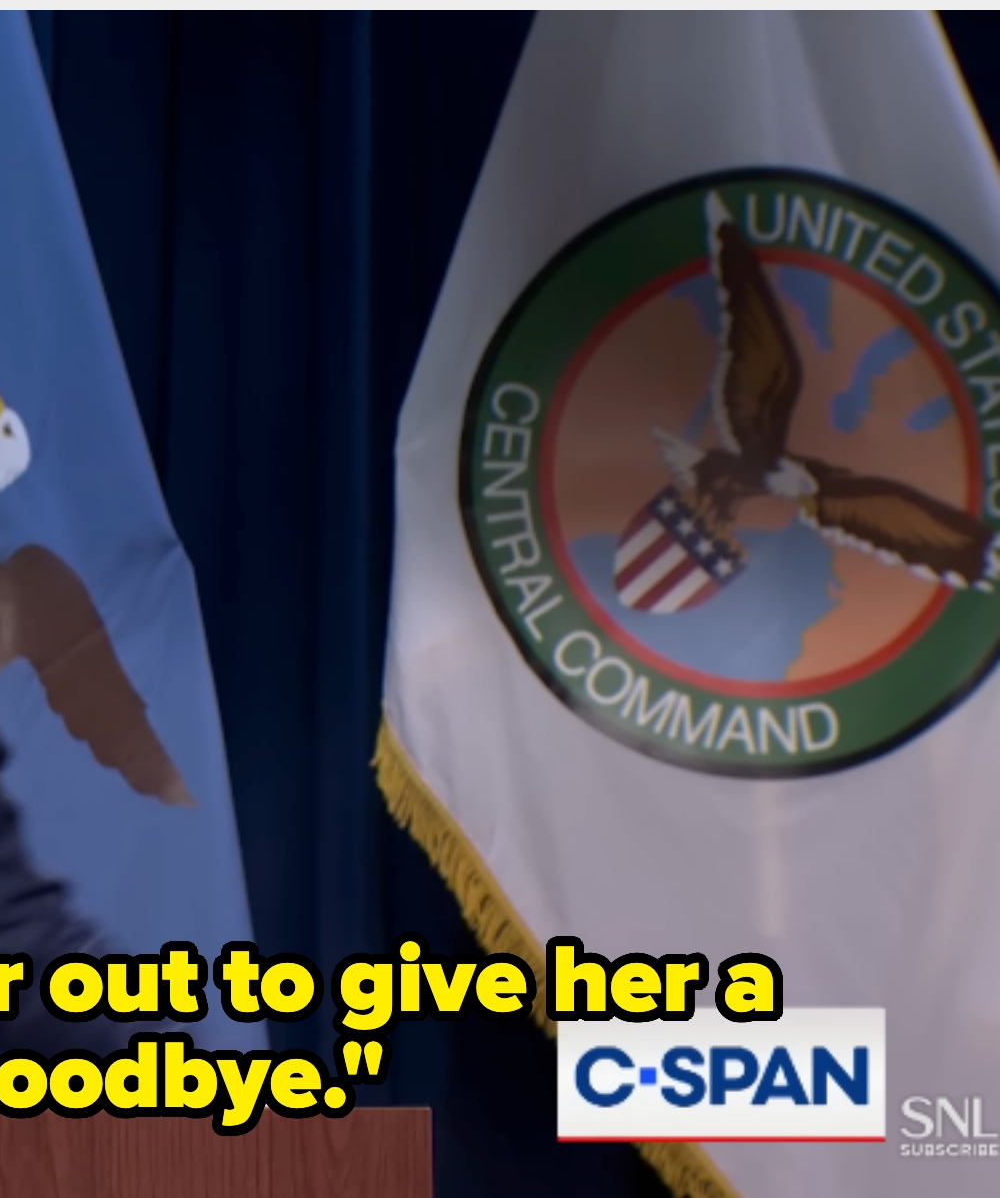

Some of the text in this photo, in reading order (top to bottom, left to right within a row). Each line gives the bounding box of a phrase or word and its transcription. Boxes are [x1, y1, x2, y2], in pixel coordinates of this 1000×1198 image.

[746, 193, 945, 305] UNITED
[481, 381, 840, 755] CENTRAL COMMAND
